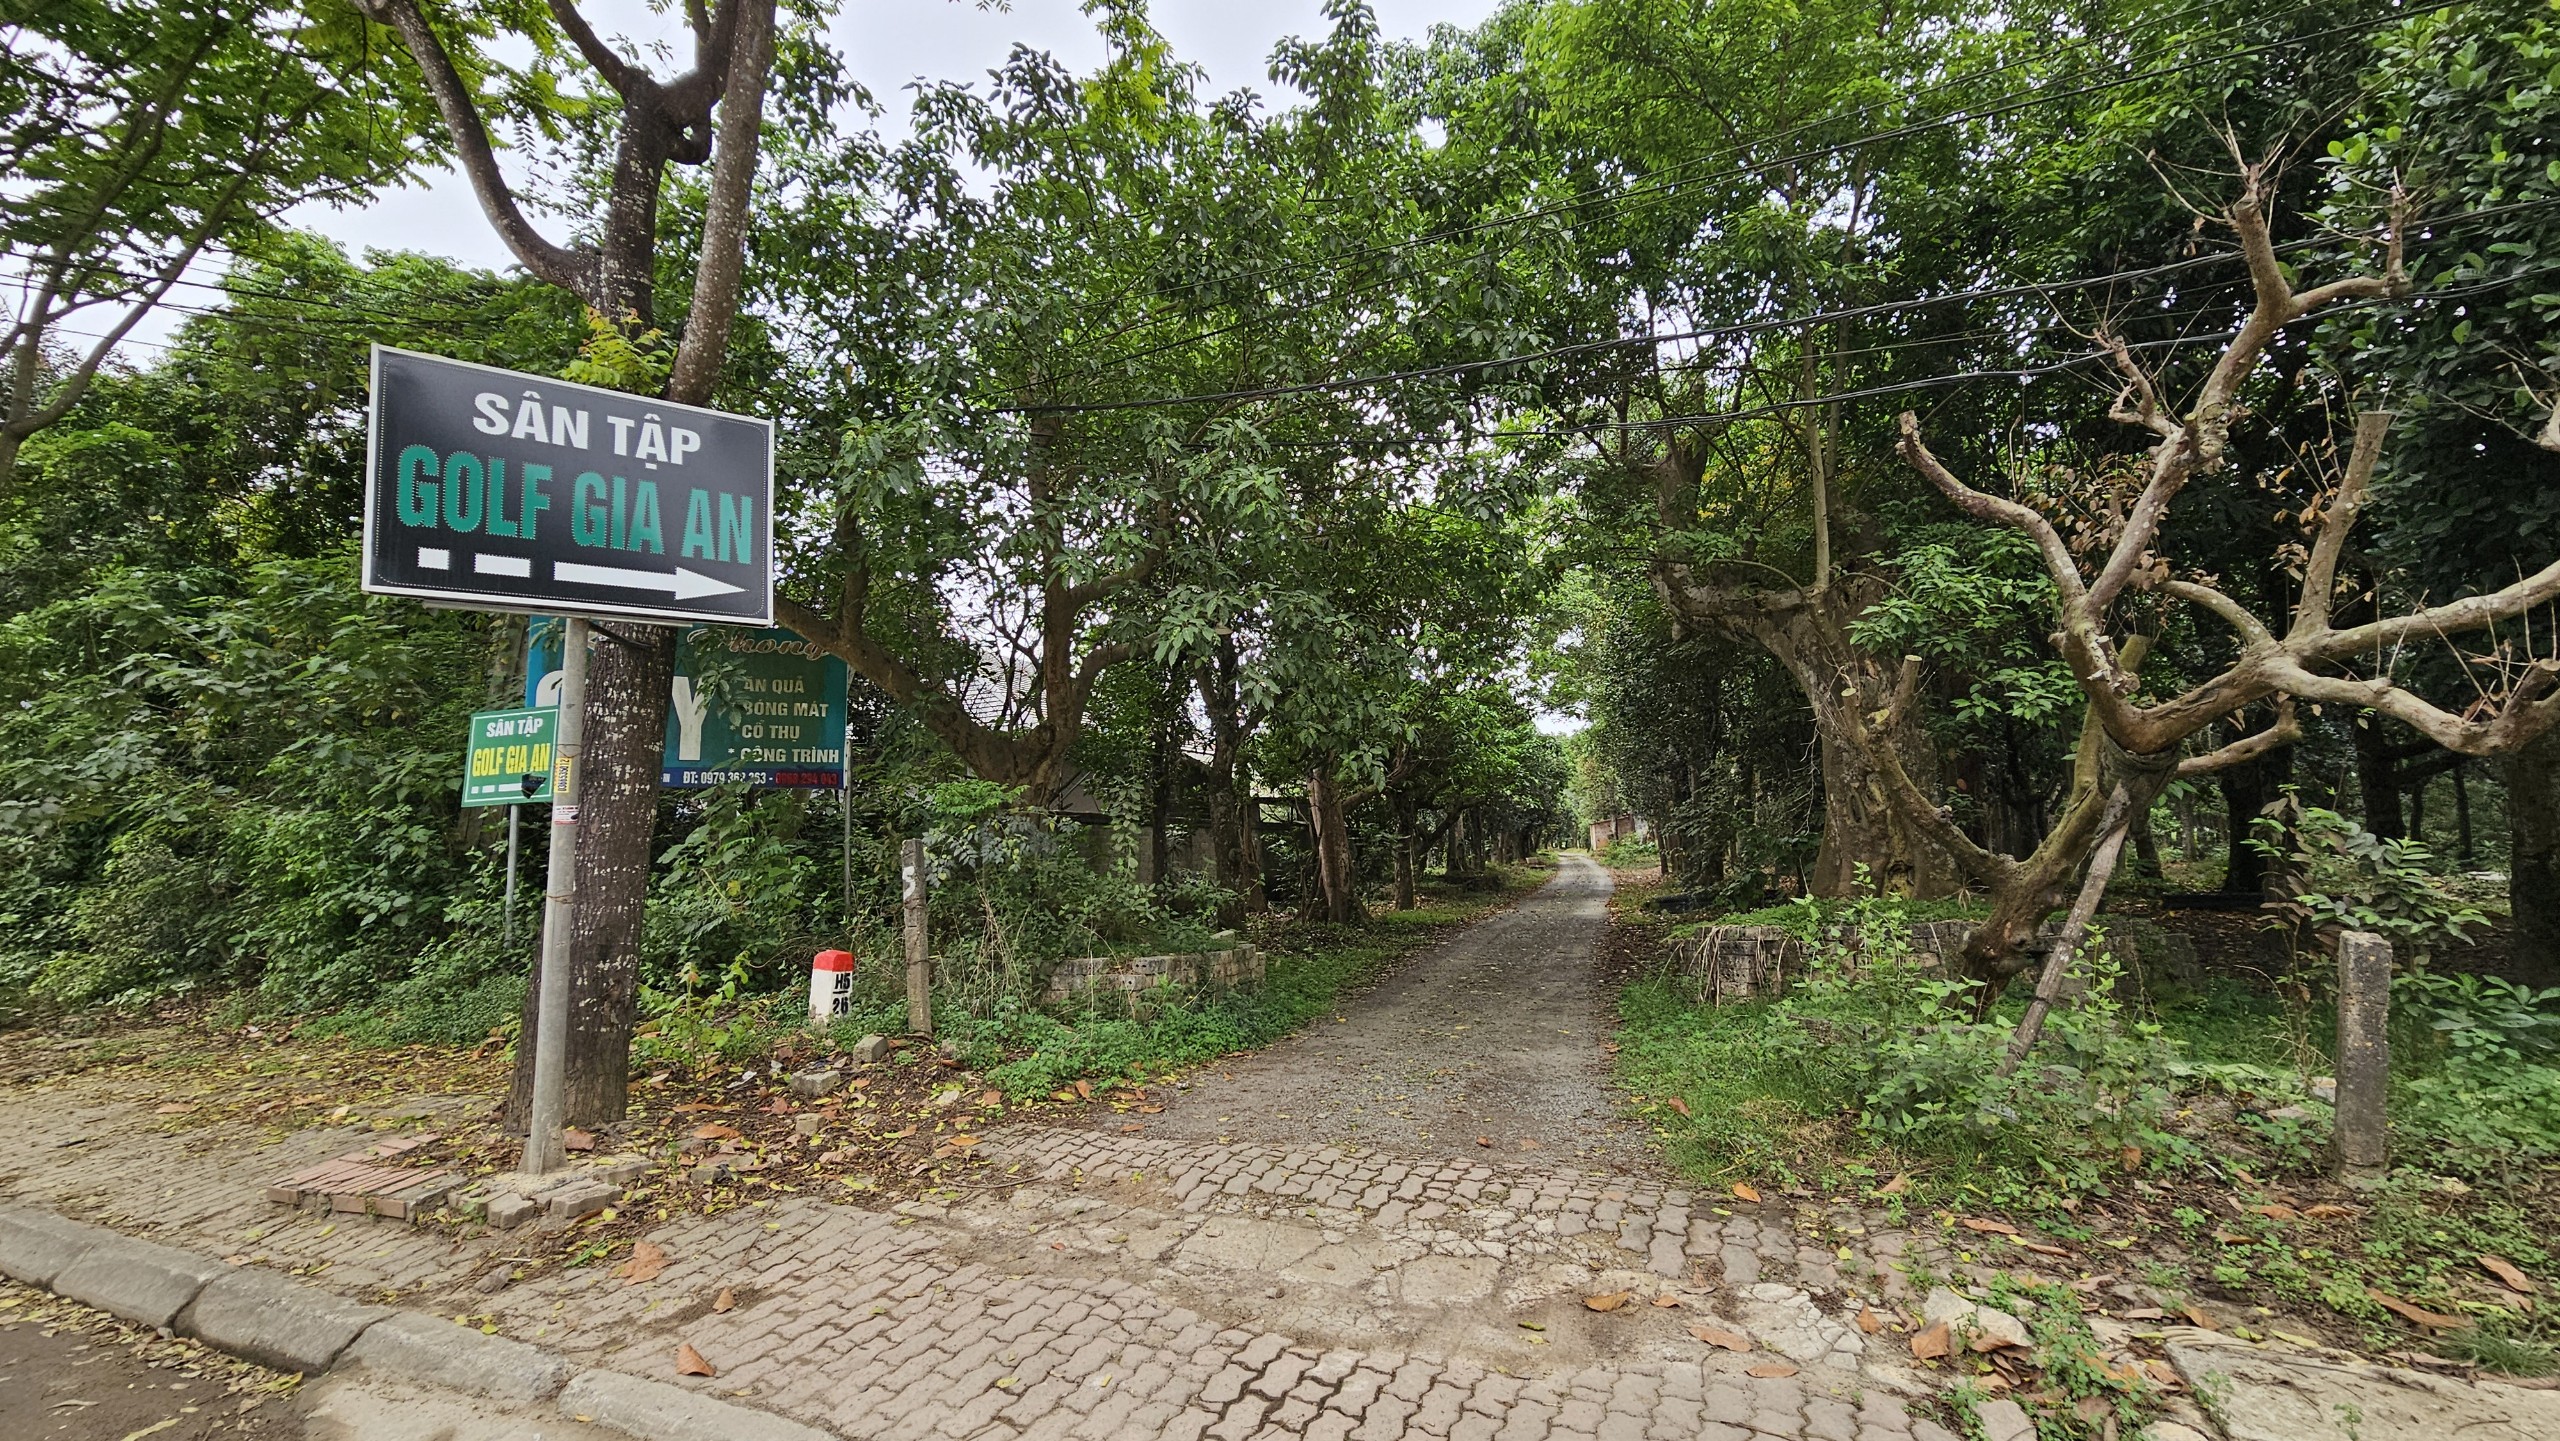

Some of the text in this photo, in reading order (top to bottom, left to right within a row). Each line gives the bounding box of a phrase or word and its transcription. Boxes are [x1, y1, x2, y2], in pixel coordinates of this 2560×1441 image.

[473, 390, 701, 469] SÂN TẬP
[397, 444, 753, 565] GOLF GIA AN
[772, 675, 805, 694] QUẢ
[744, 699, 829, 717] BÓNG MÁT
[486, 715, 544, 738] SÂN TẬP
[769, 725, 800, 742] THỤ
[472, 742, 551, 776] GOLF GIA AN
[740, 745, 839, 763] CÔNG TRÌNH
[834, 972, 851, 990] H5
[832, 997, 849, 1015] 26
